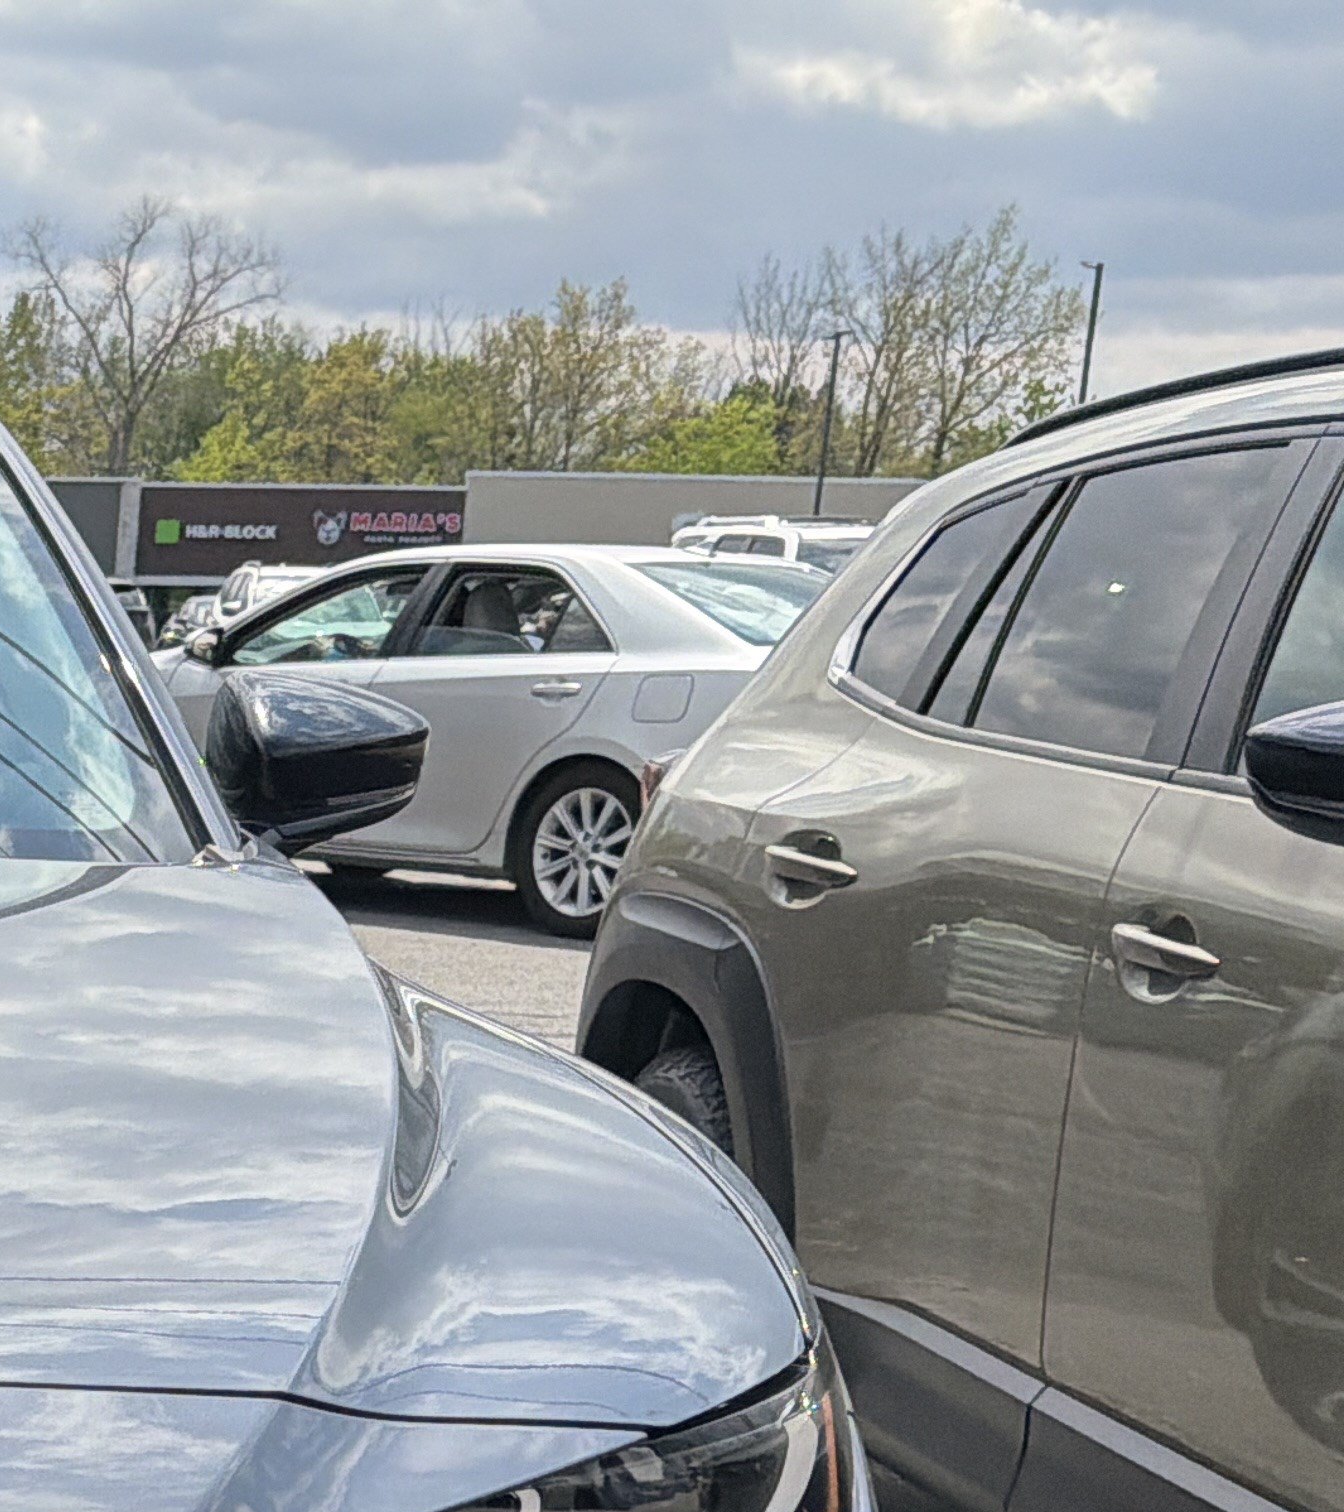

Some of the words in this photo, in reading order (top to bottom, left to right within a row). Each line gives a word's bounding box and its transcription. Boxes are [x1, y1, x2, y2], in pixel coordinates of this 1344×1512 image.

[185, 524, 219, 539] H&R
[224, 524, 278, 540] BLOCK
[350, 511, 461, 534] MARIA'S
